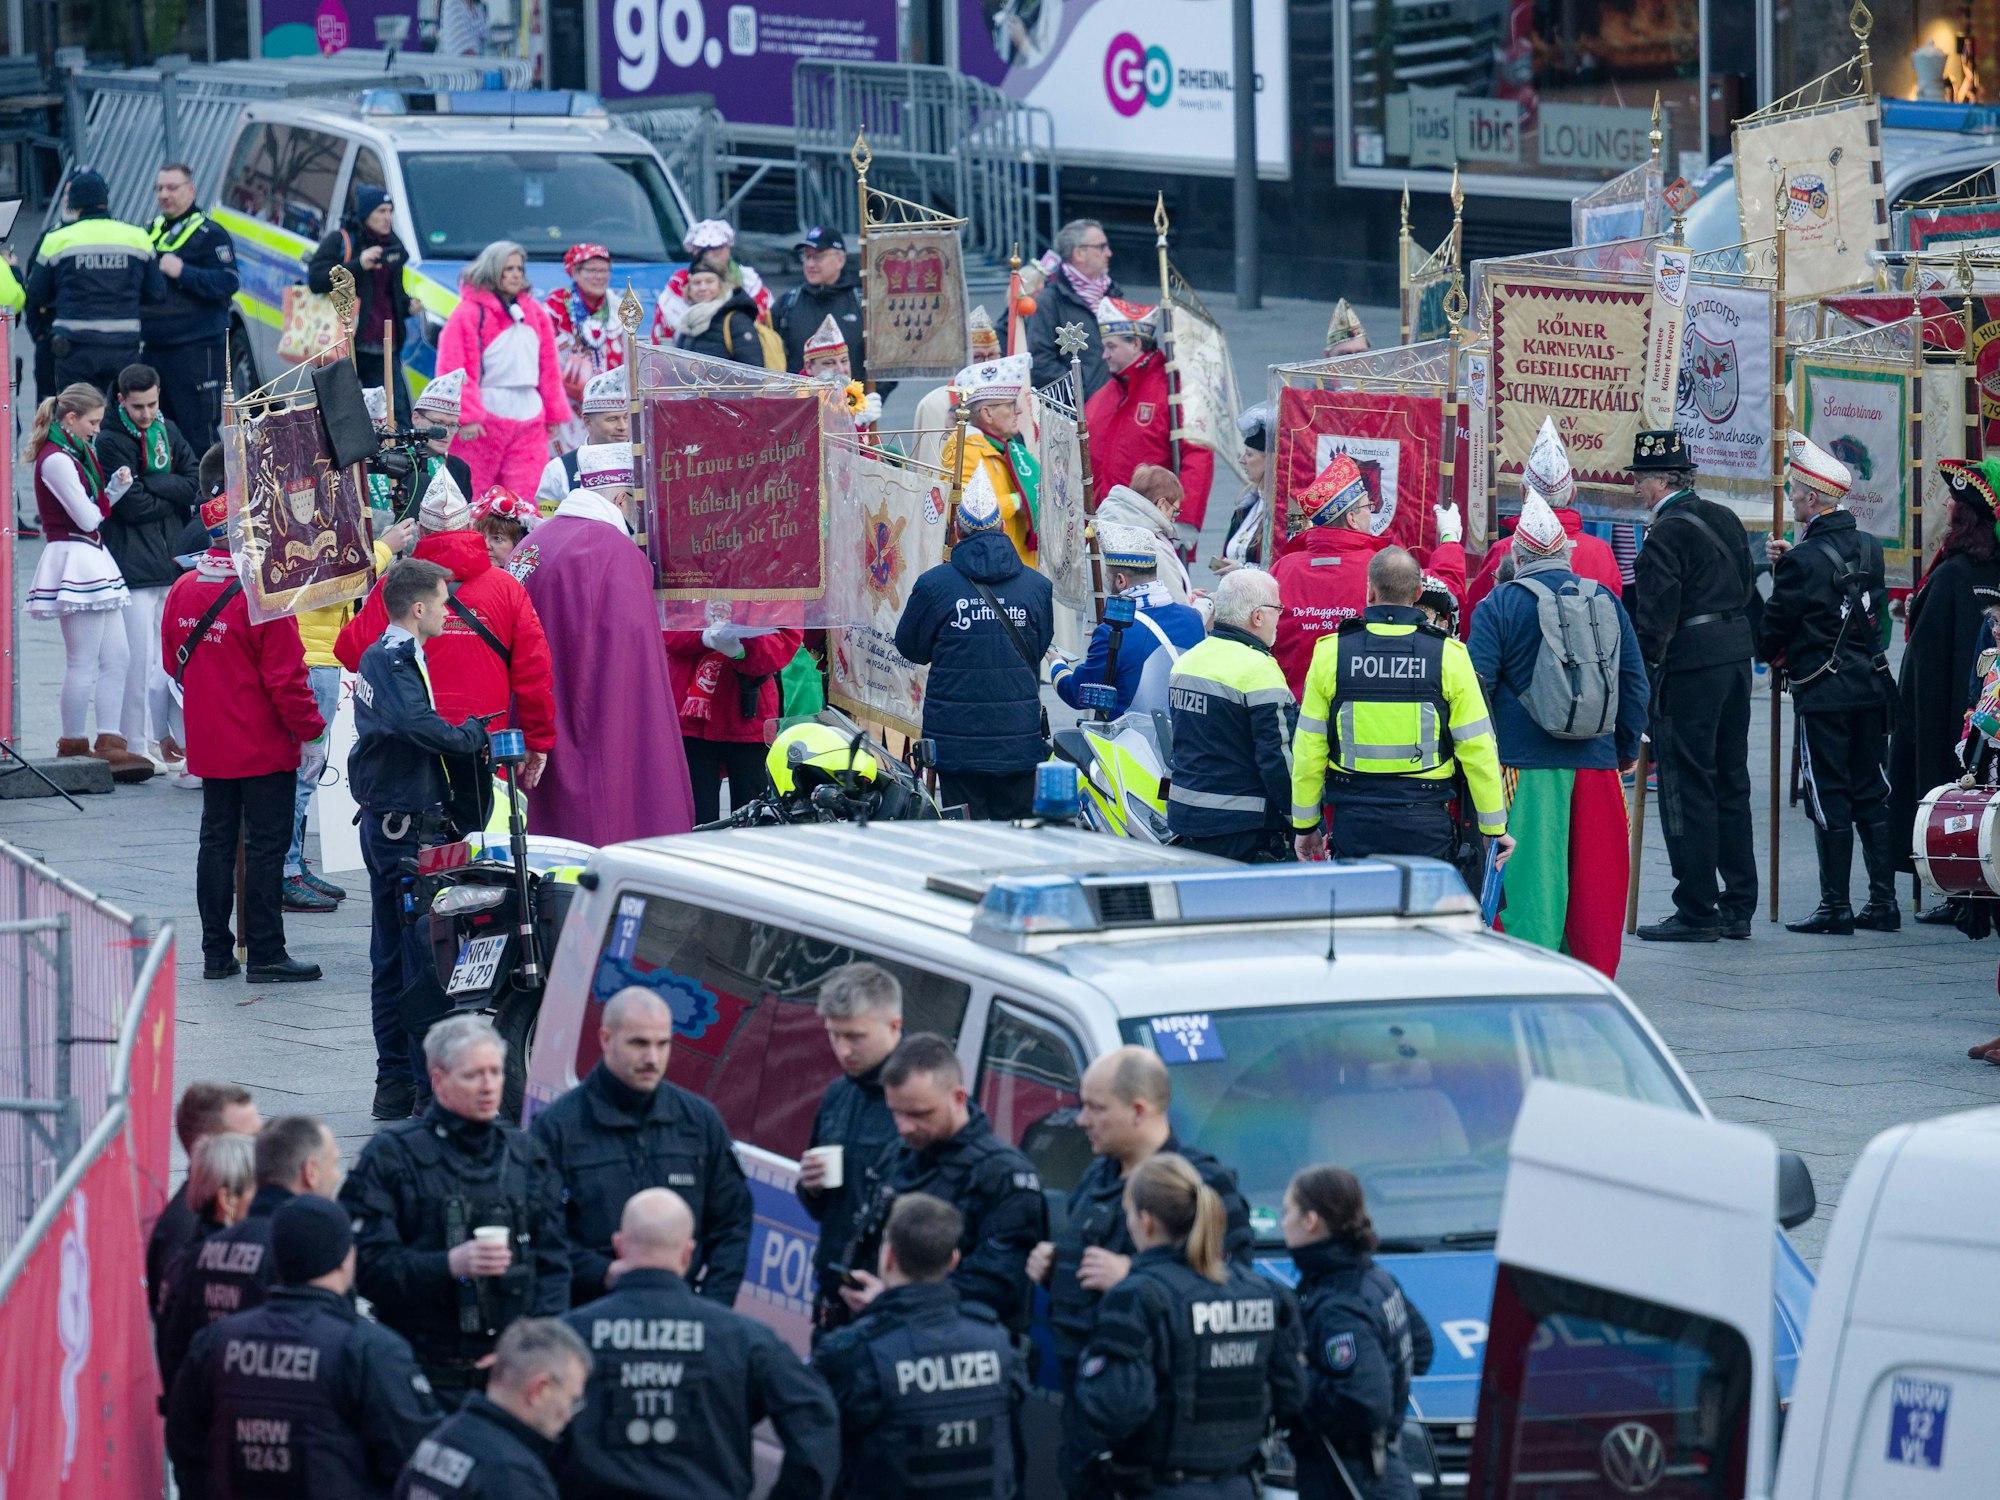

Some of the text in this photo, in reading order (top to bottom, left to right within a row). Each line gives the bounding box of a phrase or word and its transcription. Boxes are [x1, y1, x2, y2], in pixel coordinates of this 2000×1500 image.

[1108, 44, 1170, 105] GO
[1469, 108, 1514, 153] ibis
[1543, 123, 1646, 163] LOUNGE
[75, 254, 129, 270] POLIZEI
[1537, 312, 1607, 341] KÖLNER
[1523, 338, 1625, 361] KARNEVALS-
[1652, 326, 1664, 383] Festkomitee
[1660, 320, 1676, 392] Kölner Karneval
[1516, 359, 1631, 382] GESELLSCHAFT
[1505, 382, 1640, 412] SCHWAZZEKÄÄLS
[1708, 423, 1764, 445] Sandhasen
[737, 451, 755, 469] es
[1349, 445, 1390, 458] Stammtisch
[688, 484, 741, 516] kölsch
[690, 522, 743, 554] kölsch
[1292, 606, 1305, 617] De
[1322, 620, 1333, 630] 98
[1350, 655, 1427, 679] POLIZEI
[1169, 687, 1208, 715] POLIZEI
[620, 896, 647, 917] NRW
[621, 919, 636, 938] 12
[463, 938, 495, 966] NRW
[449, 963, 493, 992] 5-479
[1151, 1014, 1209, 1034] NRW
[1175, 1030, 1205, 1047] 12
[197, 1240, 265, 1275] POLIZEI
[1192, 1298, 1275, 1336] POLIZEI
[592, 1318, 705, 1352] POLIZEI
[224, 1339, 320, 1382] POLIZEI
[1210, 1340, 1259, 1368] NRW
[619, 1361, 685, 1388] NRW
[896, 1349, 1001, 1395] POLIZEI
[235, 1417, 291, 1444] NRW
[936, 1419, 978, 1449] 2T1
